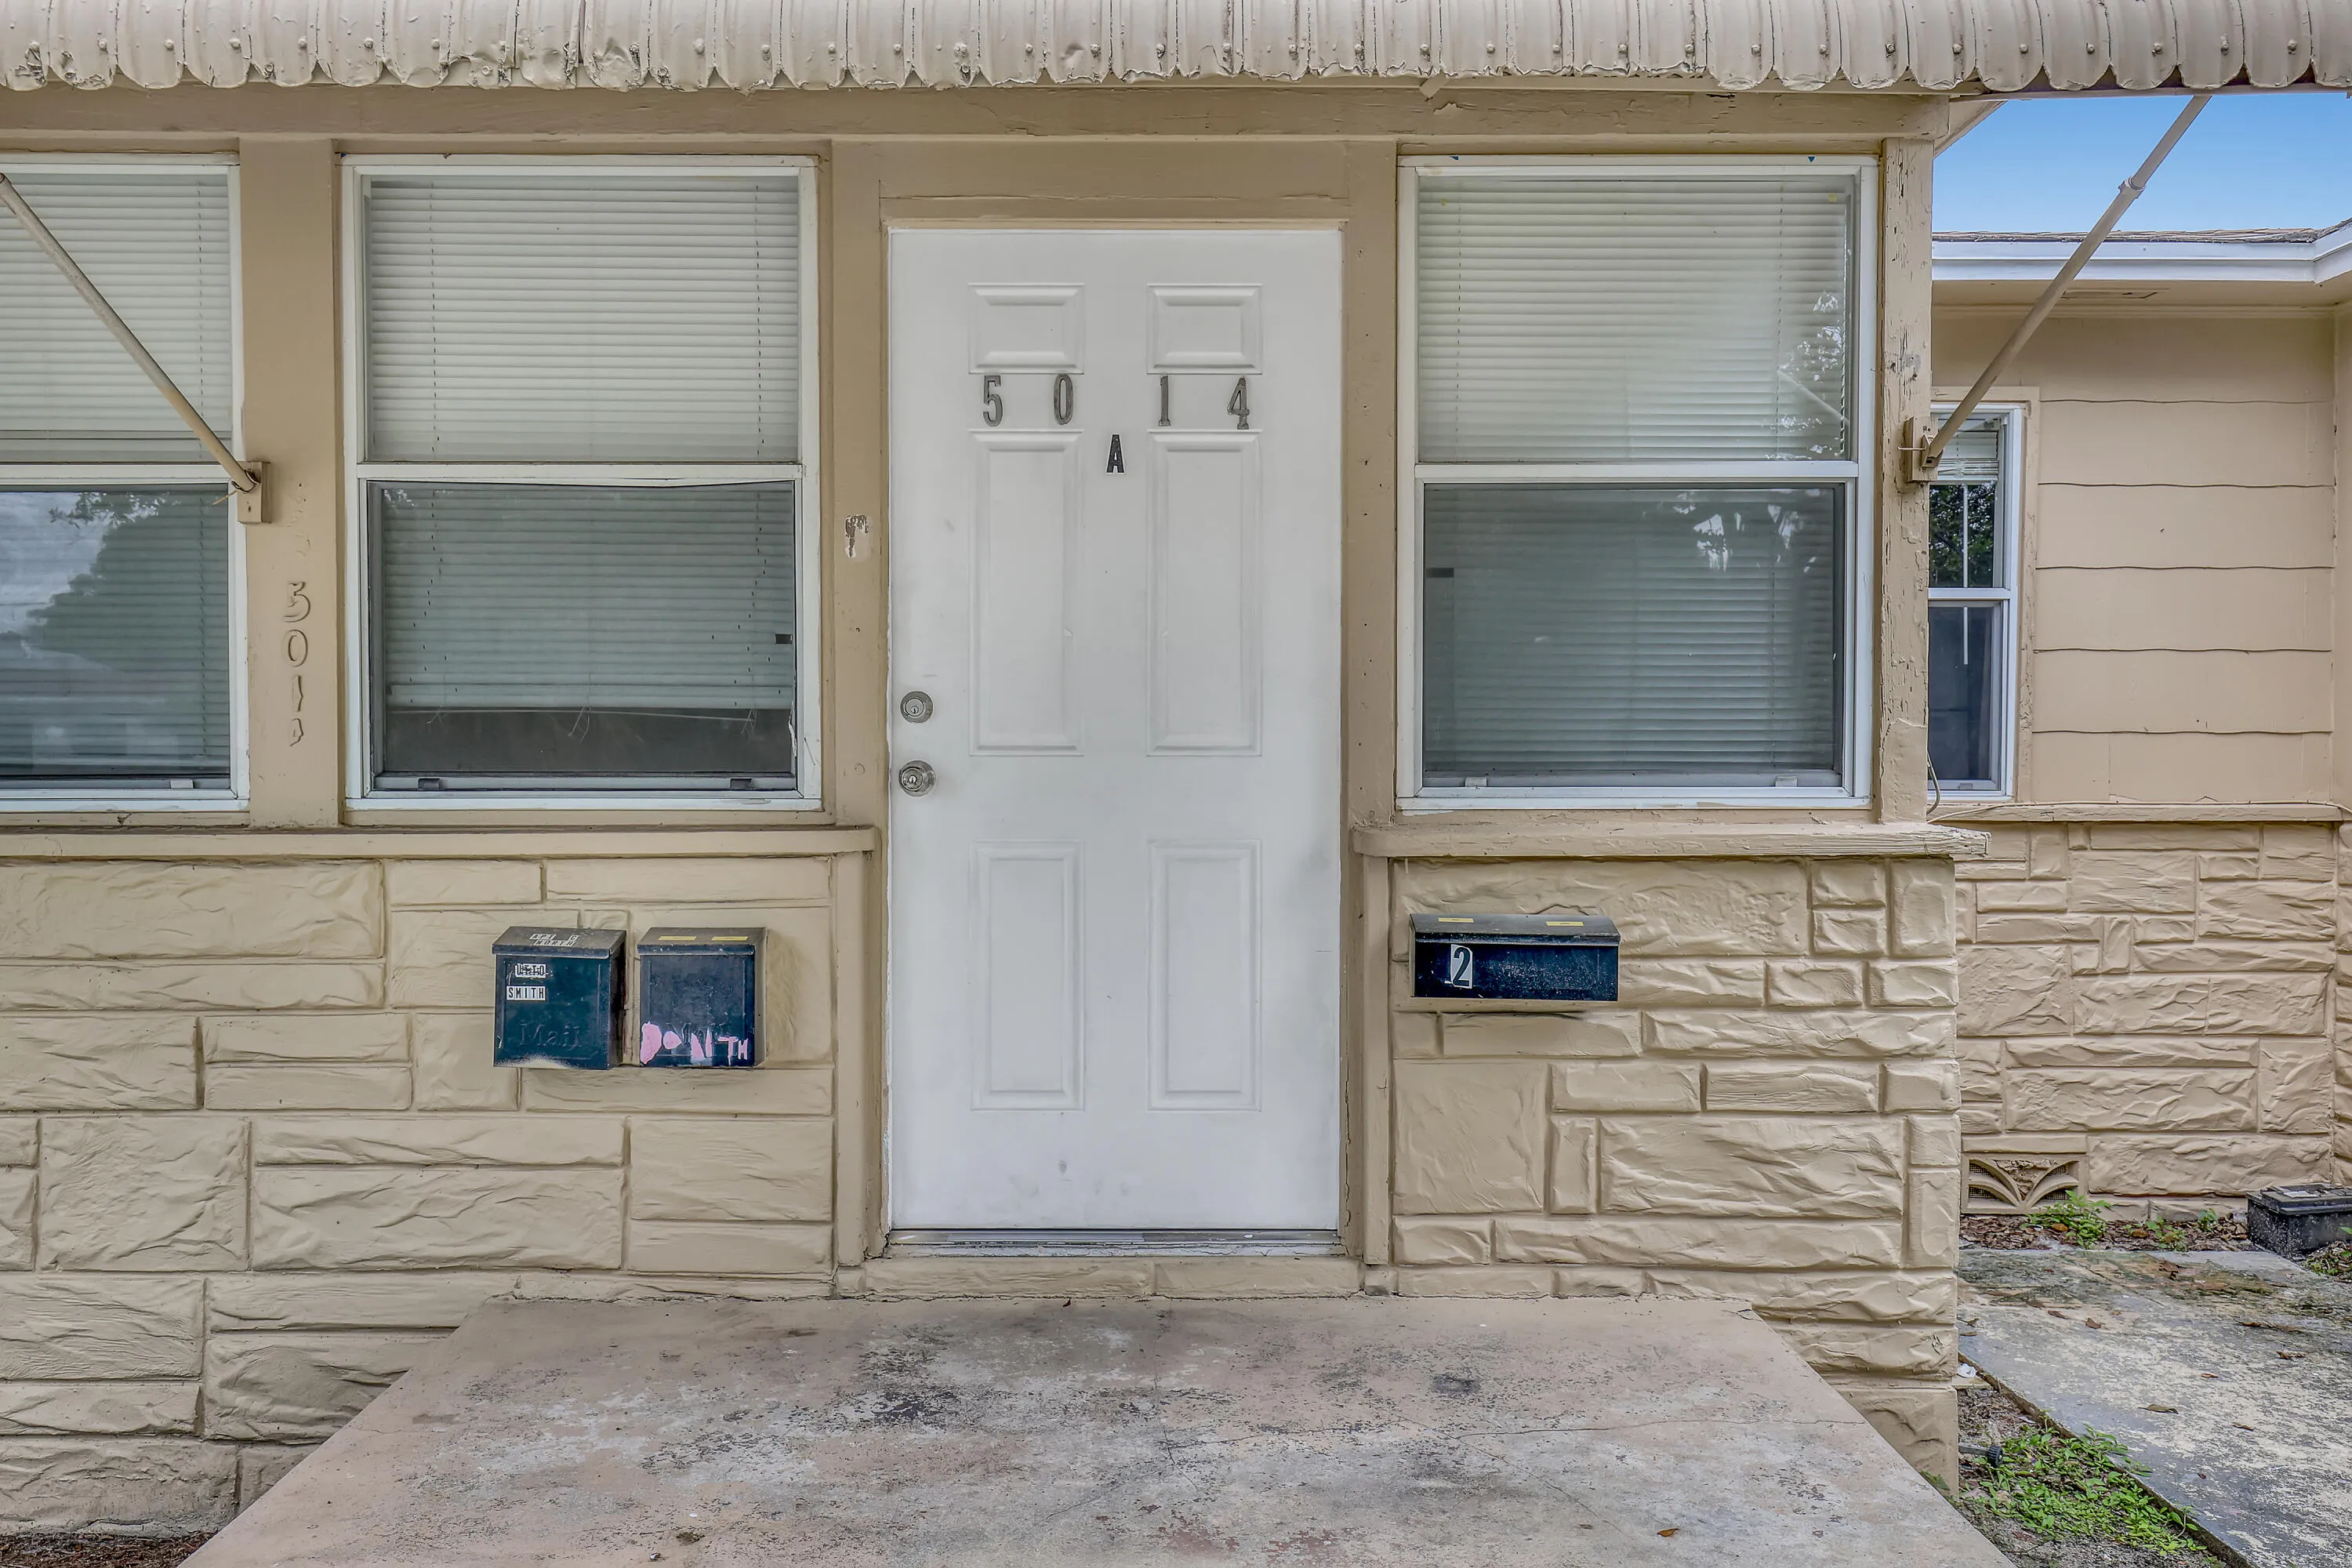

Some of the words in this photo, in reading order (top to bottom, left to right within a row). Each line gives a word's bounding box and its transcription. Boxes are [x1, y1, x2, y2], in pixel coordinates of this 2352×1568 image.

[1105, 433, 1126, 474] A
[1452, 946, 1471, 987] 2
[508, 987, 544, 999] SMITH
[518, 1022, 583, 1047] Mail
